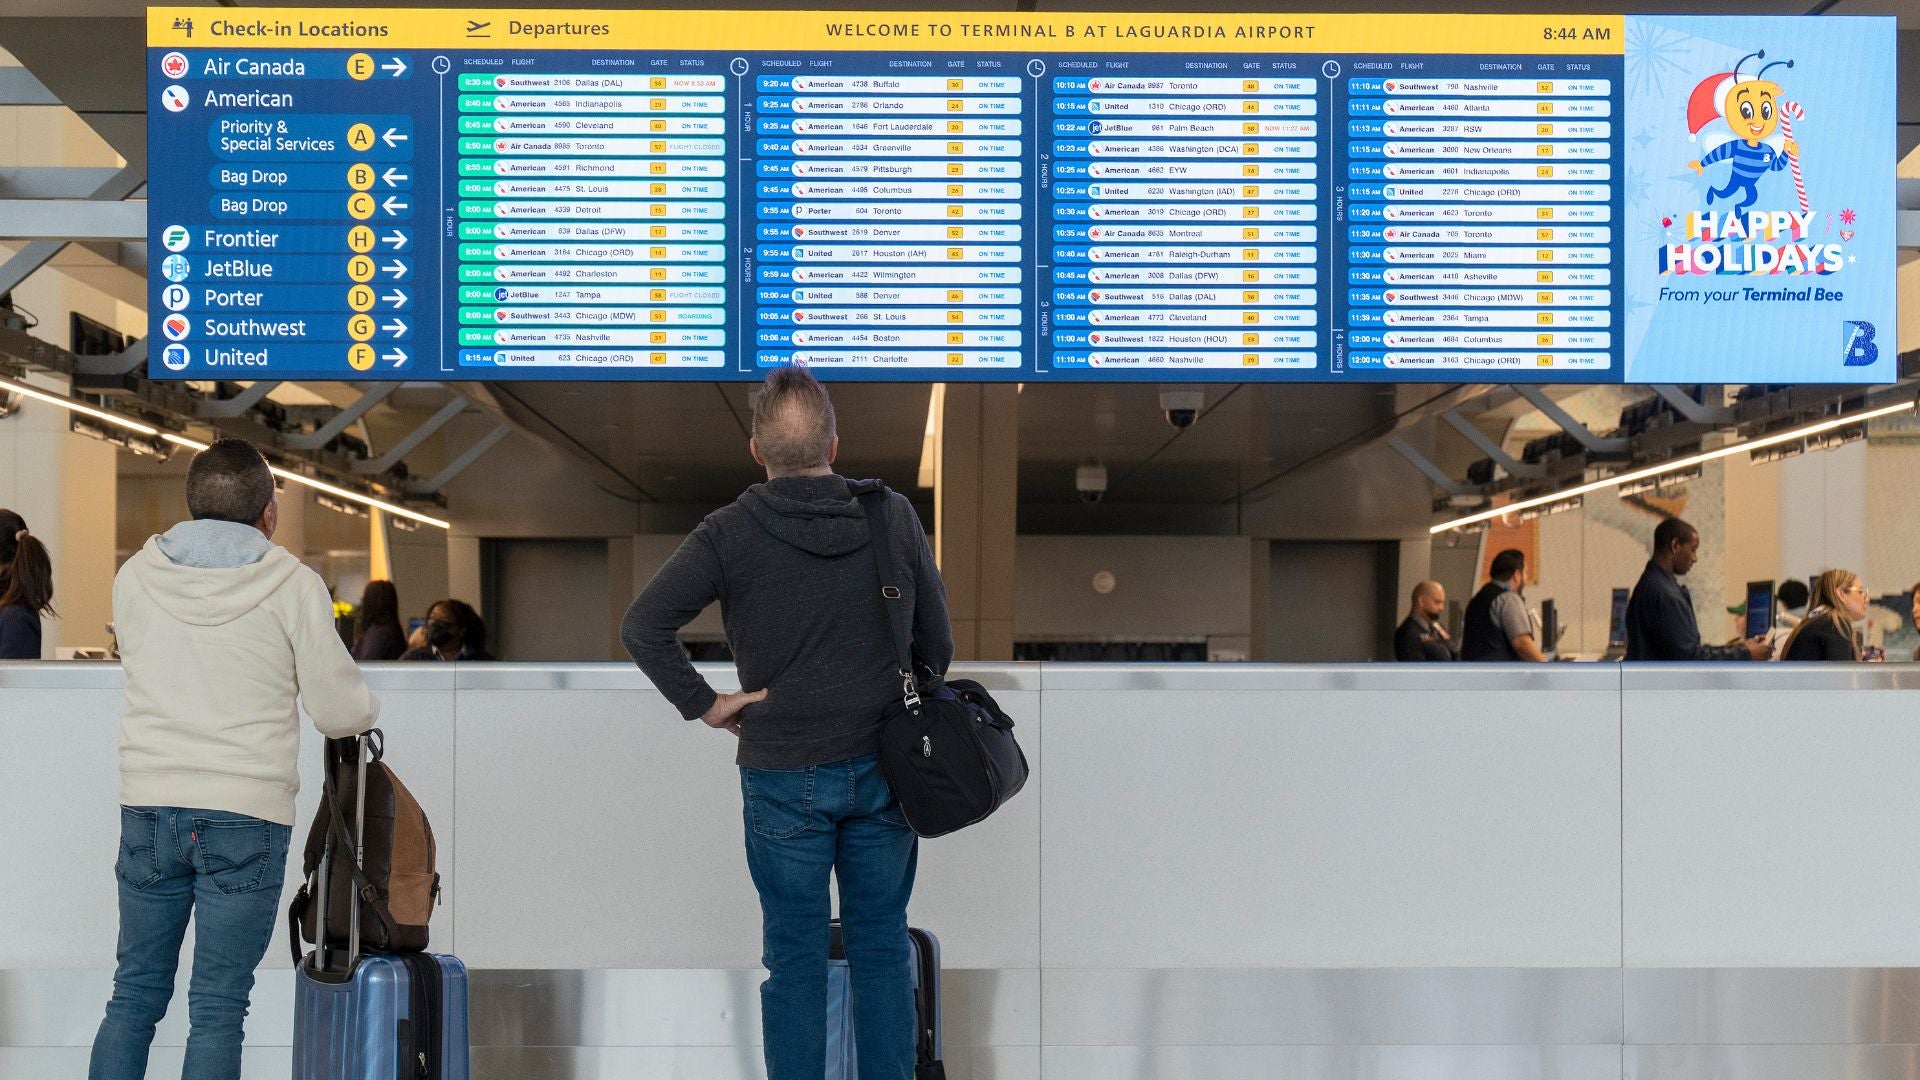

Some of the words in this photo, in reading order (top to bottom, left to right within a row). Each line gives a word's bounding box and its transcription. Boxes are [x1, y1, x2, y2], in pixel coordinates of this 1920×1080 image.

[211, 20, 291, 36] Check-in
[300, 21, 388, 36] Locations
[510, 21, 609, 38] Departures
[826, 24, 919, 36] WELCOME
[928, 25, 951, 36] TO
[961, 25, 1056, 37] TERMINAL
[1066, 26, 1074, 37] B
[1084, 26, 1106, 37] AT
[1117, 26, 1225, 38] LAGUARDIA
[1235, 26, 1315, 38] AIRPORT
[1544, 28, 1577, 39] 8:44
[1583, 28, 1609, 40] AM
[204, 58, 230, 74] Air
[236, 58, 304, 75] Canada
[356, 60, 364, 74] E
[205, 90, 292, 106] American
[576, 101, 622, 109] Indianapolis
[222, 120, 272, 136] Priority
[277, 120, 288, 133] &
[354, 130, 367, 144] A
[221, 137, 271, 153] Special
[276, 137, 334, 151] Services
[1169, 146, 1213, 154] Washington
[1763, 153, 1770, 162] B
[356, 170, 366, 184] B
[874, 166, 912, 174] Pittsburgh
[222, 170, 247, 185] Bag
[253, 170, 287, 186] Drop
[222, 199, 247, 215] Bag
[253, 199, 287, 214] Drop
[354, 198, 365, 213] C
[602, 228, 625, 236] (DFW)
[1694, 211, 1817, 239] HAPPY
[206, 230, 279, 247] Frontier
[355, 232, 366, 247] H
[576, 249, 607, 257] Chicago
[610, 249, 633, 257] (ORD)
[908, 250, 926, 258] (IAH)
[1170, 251, 1230, 259] Raleigh-Durham
[1667, 244, 1844, 272] HOLIDAYS
[205, 260, 272, 277] JetBlue
[356, 262, 368, 276] D
[873, 272, 915, 280] Wilmington
[206, 290, 263, 306] Porter
[356, 291, 368, 305] D
[1659, 288, 1699, 301] From
[1704, 291, 1739, 304] your
[1743, 287, 1811, 301] Terminal
[1814, 288, 1843, 301] Bee
[206, 319, 305, 336] Southwest
[354, 320, 367, 334] G
[206, 348, 267, 365] United
[357, 349, 365, 364] F
